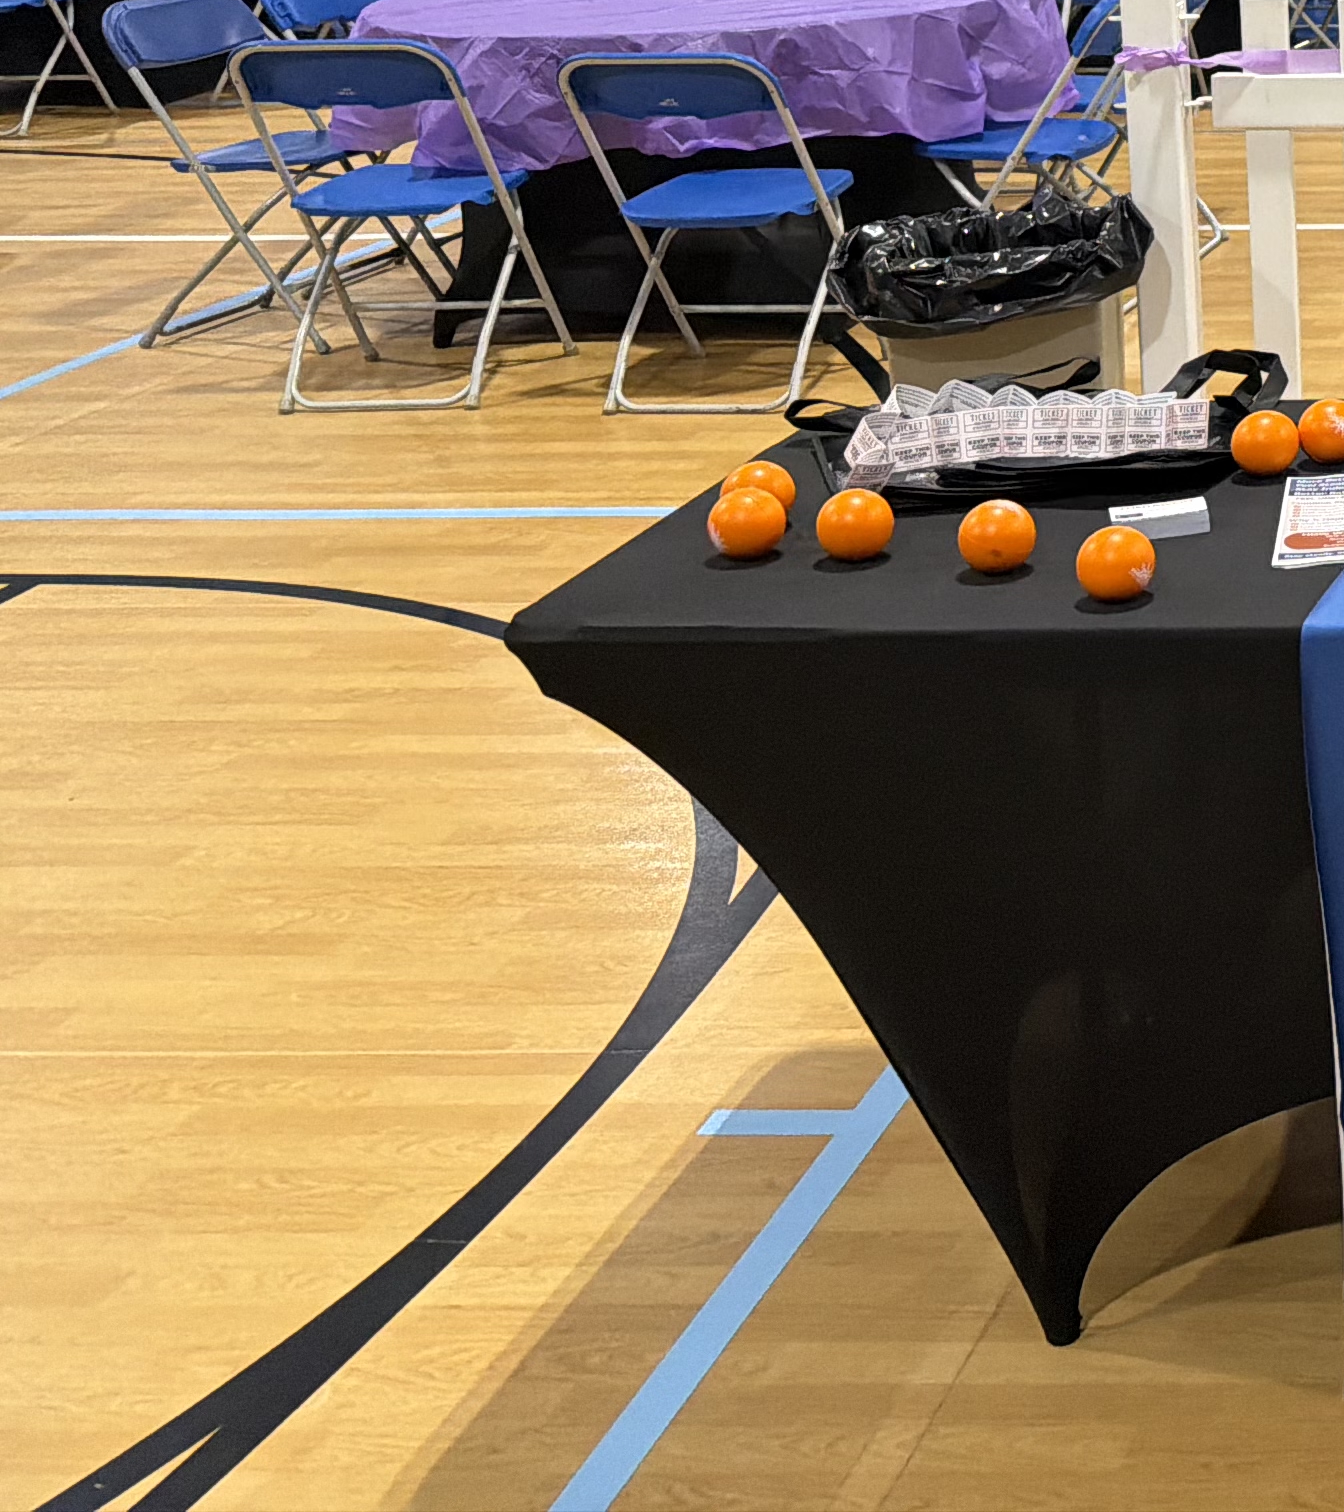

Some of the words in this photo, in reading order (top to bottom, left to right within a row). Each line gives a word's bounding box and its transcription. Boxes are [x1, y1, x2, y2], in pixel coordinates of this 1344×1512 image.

[1133, 408, 1158, 417] TICKET
[1179, 404, 1204, 413] TICKET
[1040, 409, 1065, 418] TICKET
[896, 422, 923, 433] TICKET
